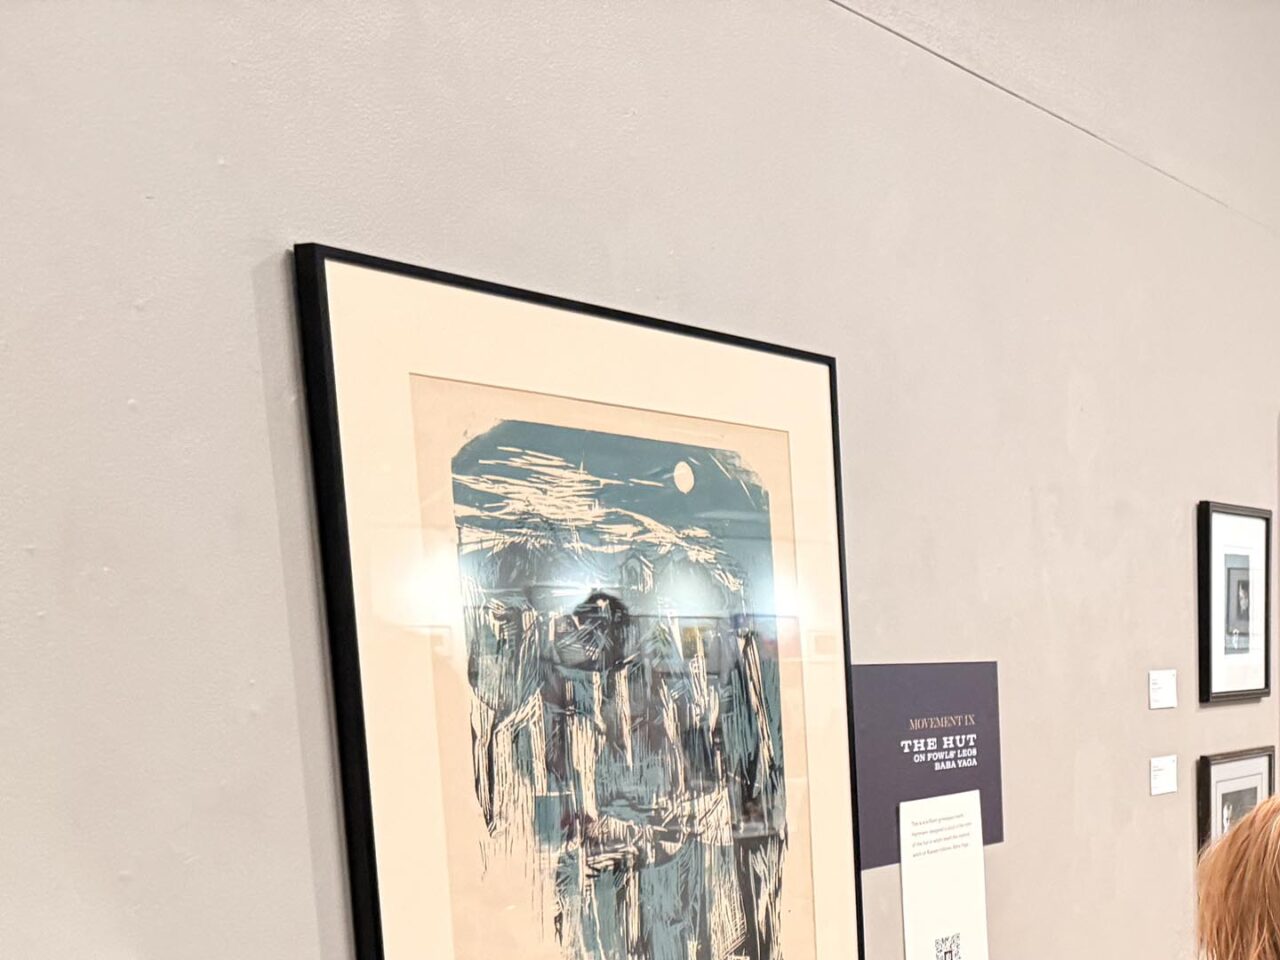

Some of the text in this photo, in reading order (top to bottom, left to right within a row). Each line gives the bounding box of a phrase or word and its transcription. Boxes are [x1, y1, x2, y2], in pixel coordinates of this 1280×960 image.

[909, 713, 976, 731] MOVEMENT IX
[900, 734, 977, 753] THE HUT
[913, 753, 926, 763] ON
[934, 758, 978, 771] BABA YAGA
